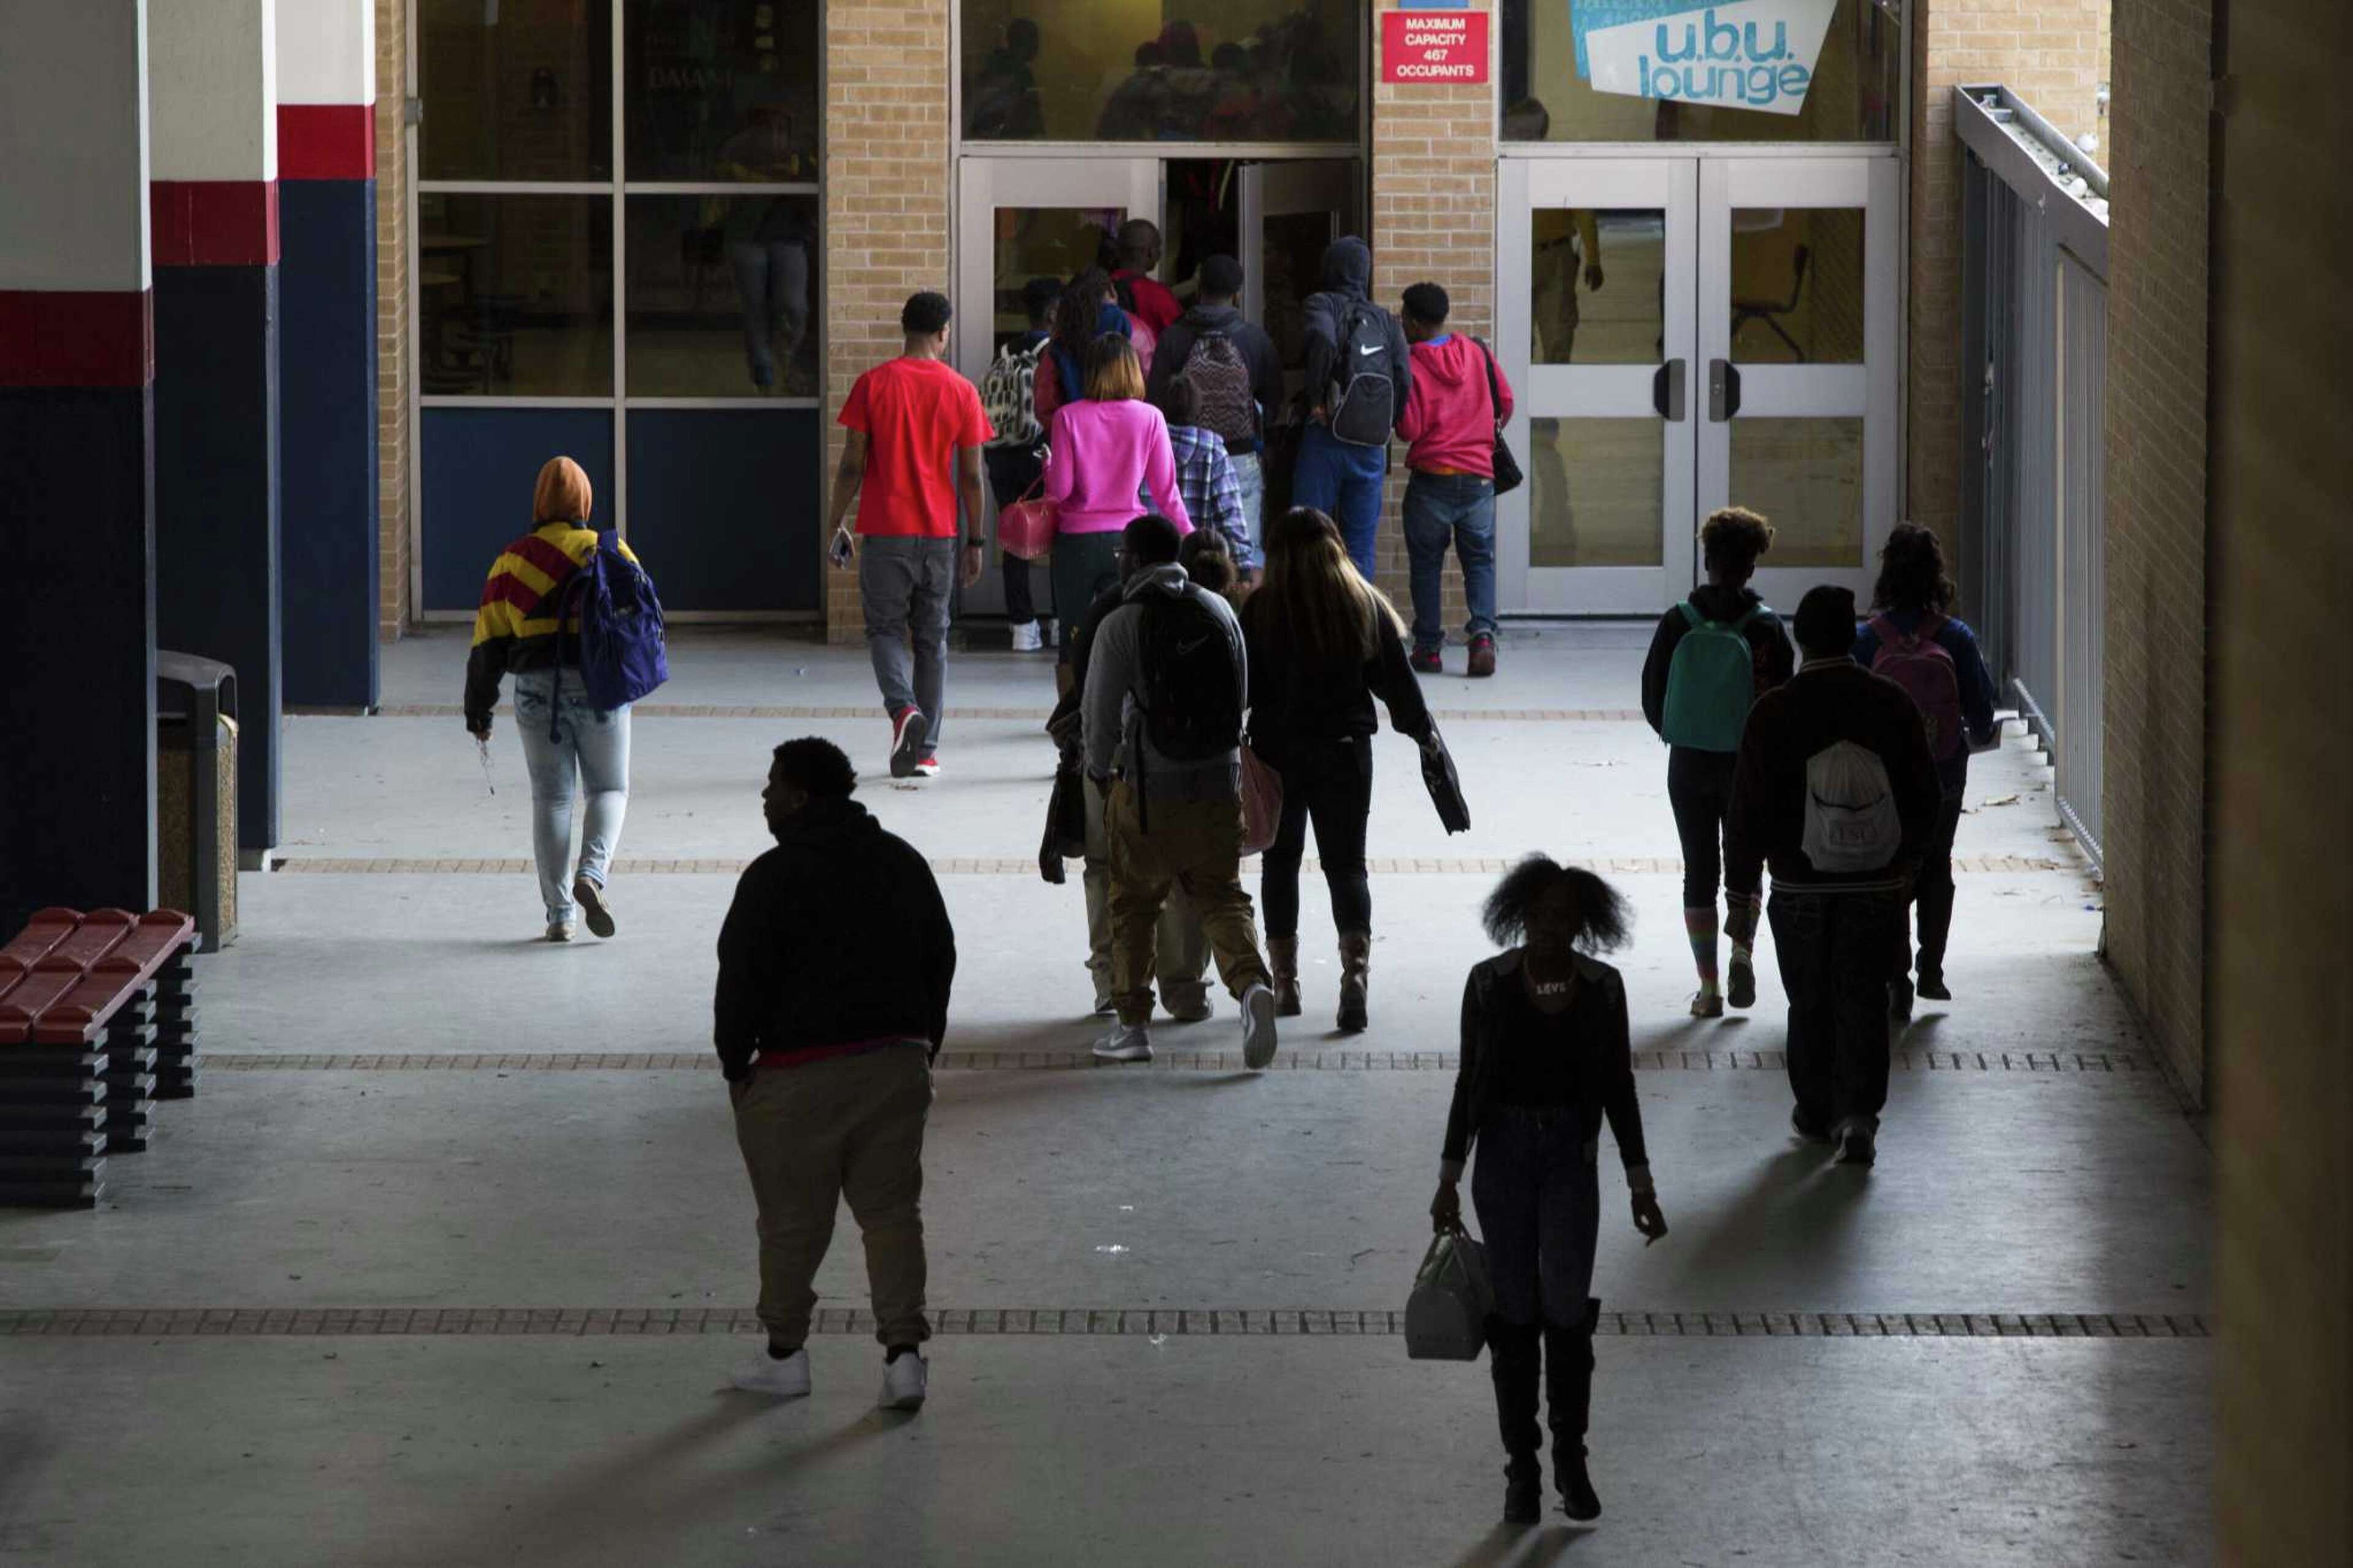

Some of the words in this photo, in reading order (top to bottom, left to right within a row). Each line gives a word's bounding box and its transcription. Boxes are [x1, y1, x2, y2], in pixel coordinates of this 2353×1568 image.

[1406, 18, 1466, 30] MAXIMUM
[1404, 33, 1466, 46] CAPACITY
[1656, 9, 1795, 62] u.b.u.
[1396, 64, 1474, 77] OCCUPANTS
[1639, 55, 1811, 105] lounge
